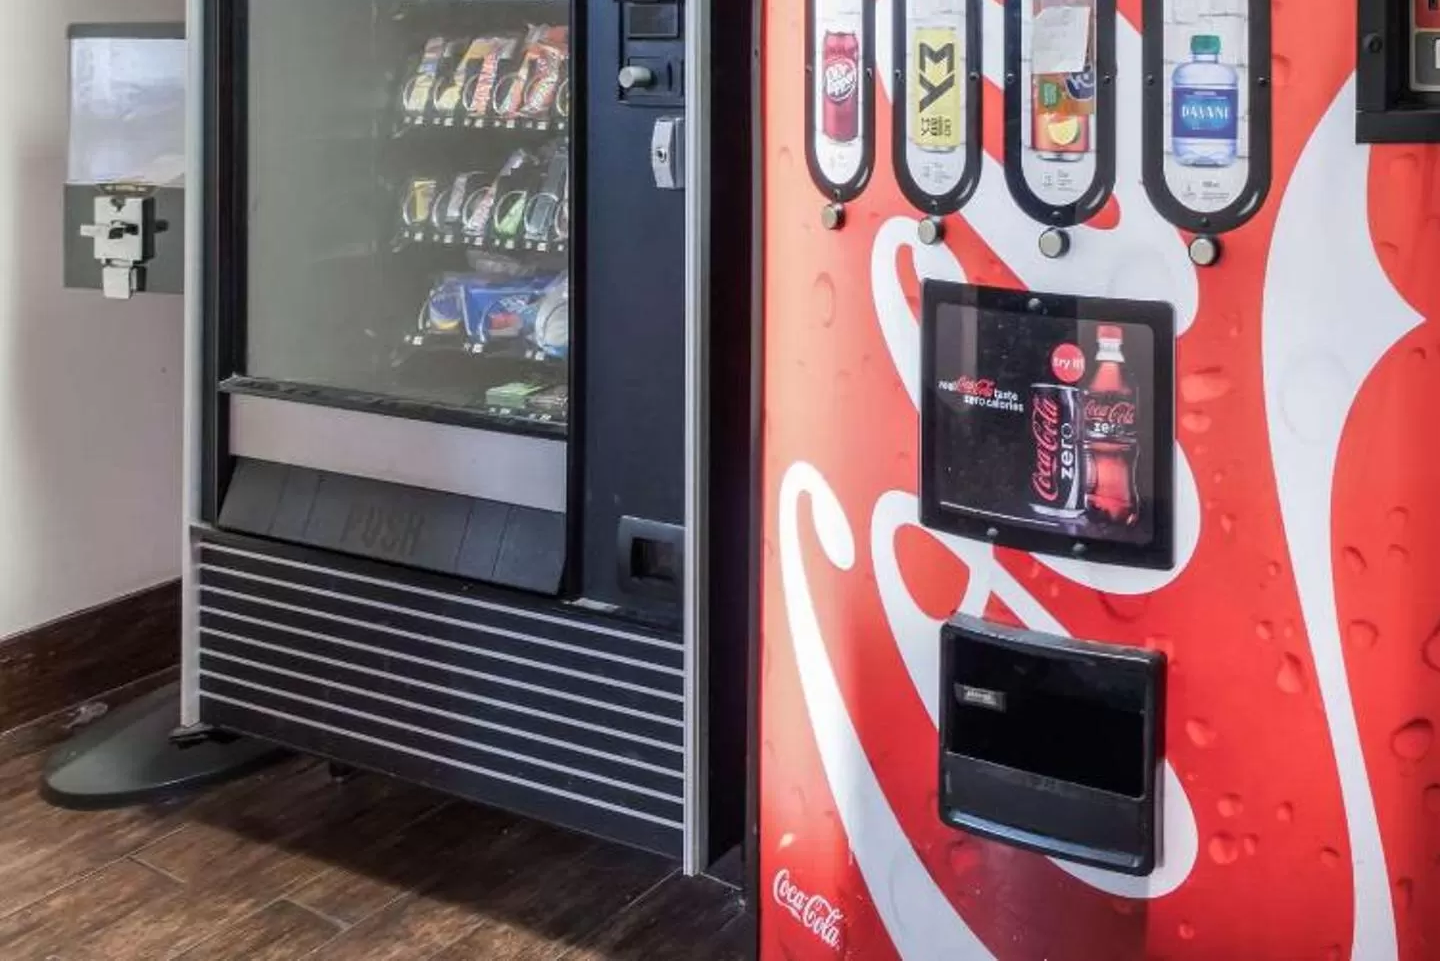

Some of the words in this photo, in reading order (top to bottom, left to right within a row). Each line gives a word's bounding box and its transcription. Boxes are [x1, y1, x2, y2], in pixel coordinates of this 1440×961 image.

[1053, 357, 1071, 369] try
[964, 394, 986, 406] zero
[986, 398, 1025, 413] calories
[994, 388, 1018, 401] taste
[1032, 394, 1060, 501] Coca-Cola
[1060, 423, 1074, 480] zero
[773, 868, 844, 950] Coca-Cola
